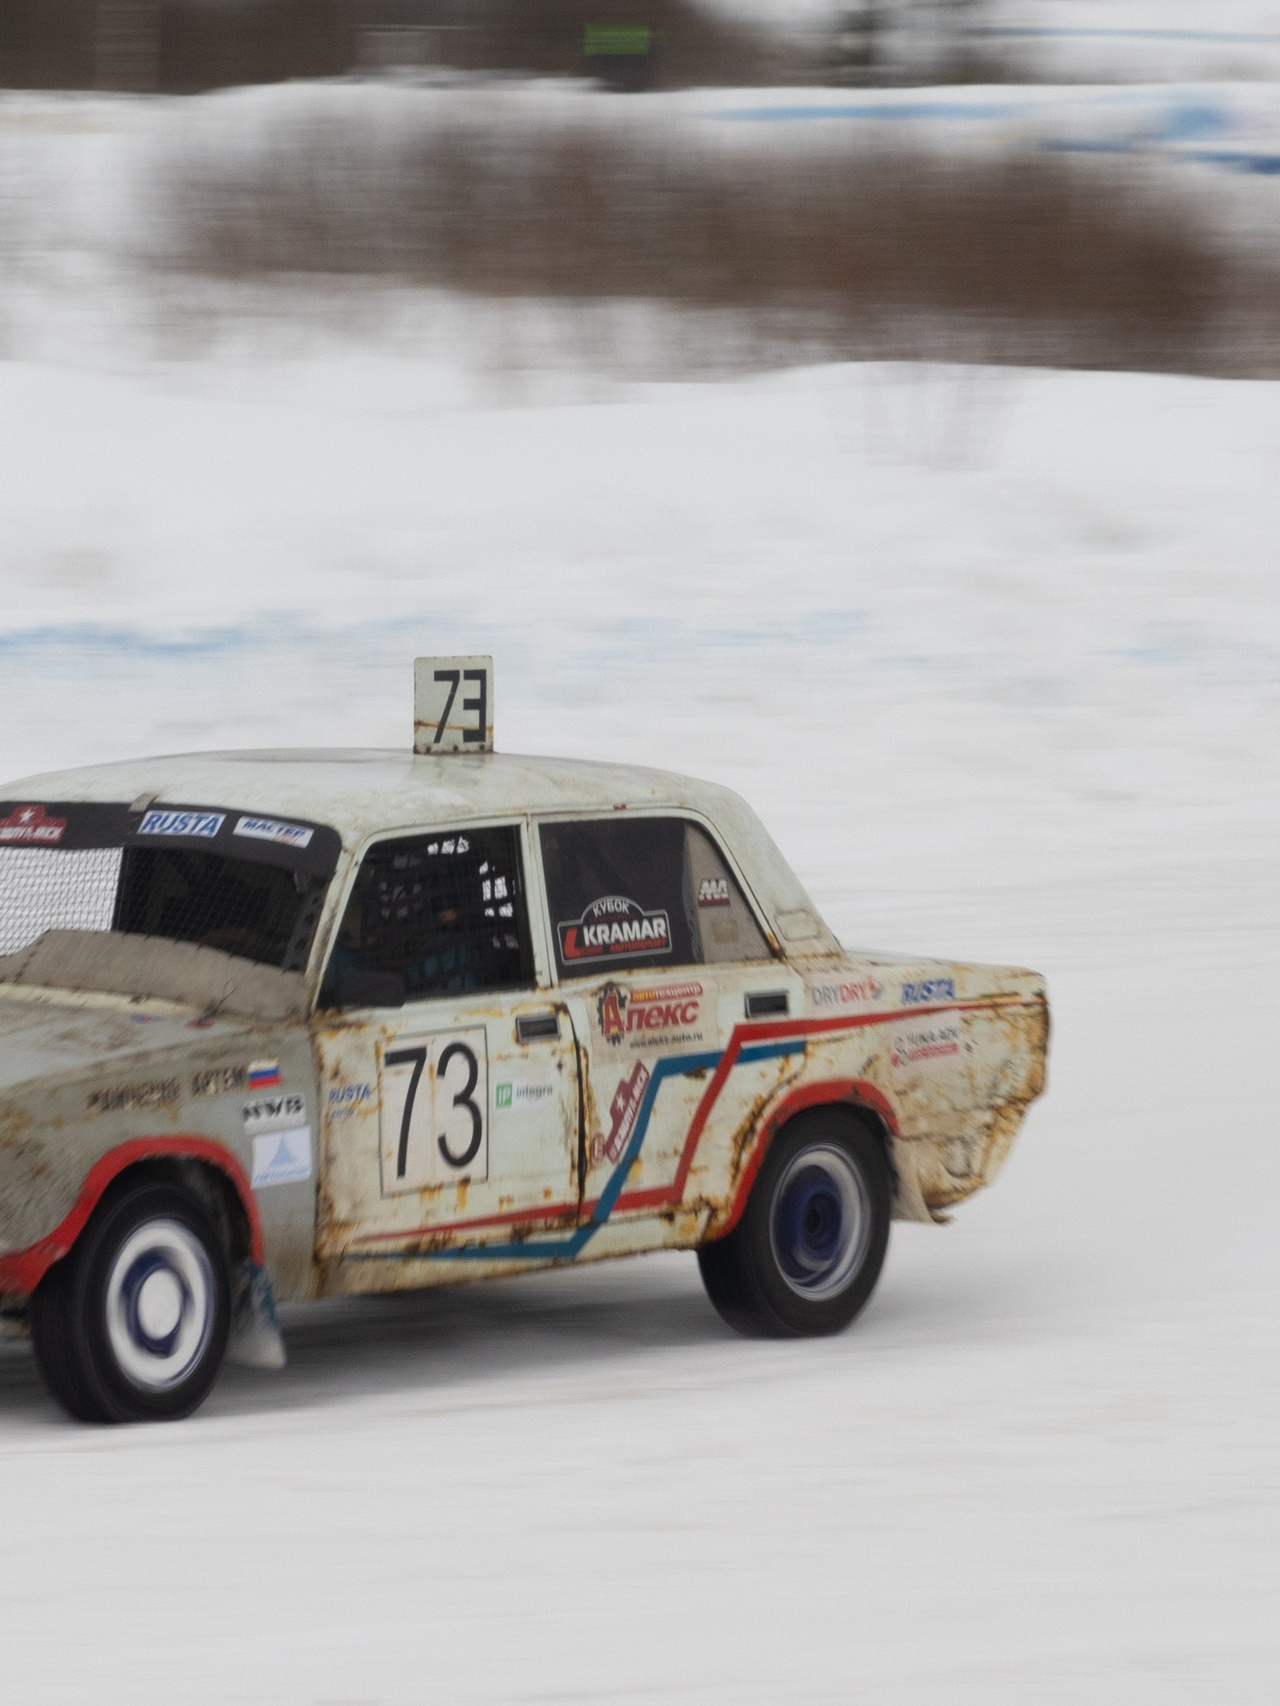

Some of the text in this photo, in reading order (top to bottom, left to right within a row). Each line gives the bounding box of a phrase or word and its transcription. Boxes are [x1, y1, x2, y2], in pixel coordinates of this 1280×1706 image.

[433, 669, 487, 744] 73
[141, 813, 220, 834] RUSTA
[582, 917, 667, 947] KRAMAR
[384, 1041, 483, 1180] 73
